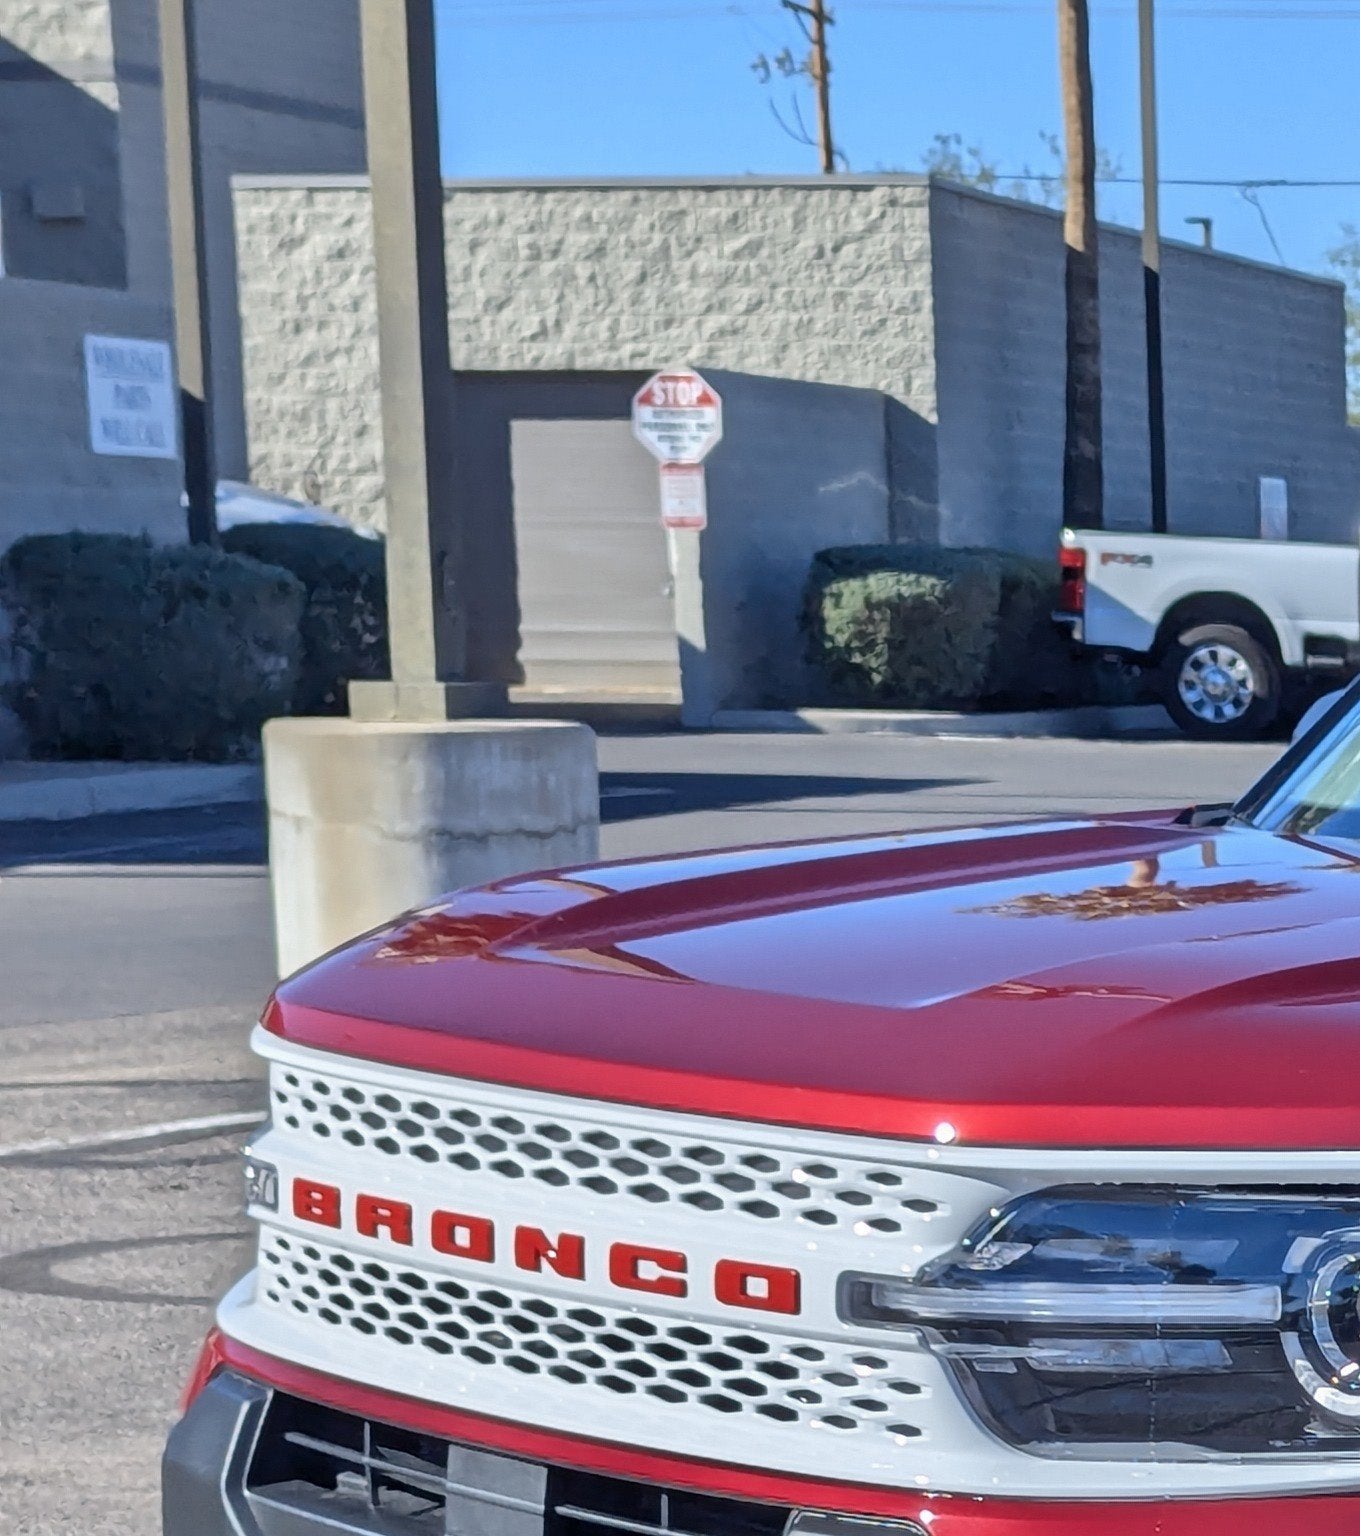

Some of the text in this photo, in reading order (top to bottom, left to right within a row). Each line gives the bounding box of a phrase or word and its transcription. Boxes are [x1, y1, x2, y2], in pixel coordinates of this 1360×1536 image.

[653, 380, 703, 405] STOP
[1101, 552, 1155, 568] FX4
[292, 1177, 802, 1316] BRONCO
